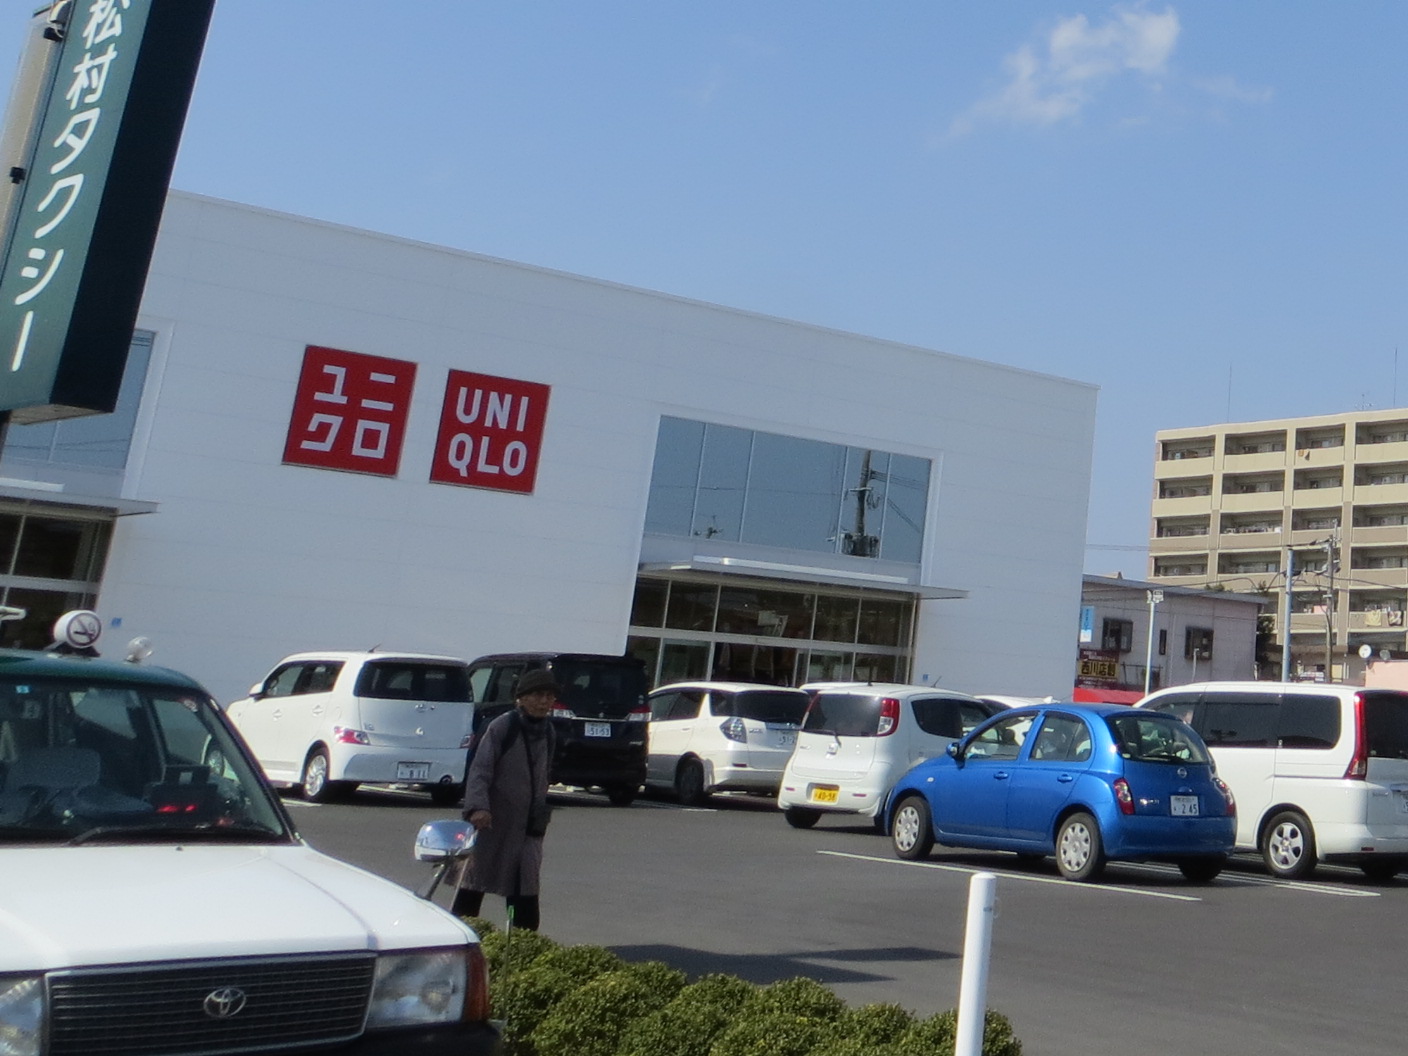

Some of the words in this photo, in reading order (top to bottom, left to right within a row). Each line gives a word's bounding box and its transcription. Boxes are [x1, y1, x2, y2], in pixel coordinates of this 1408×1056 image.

[314, 364, 396, 412] ユニ
[456, 386, 529, 432] UNI
[300, 412, 391, 460] クロ
[448, 433, 528, 477] QLO
